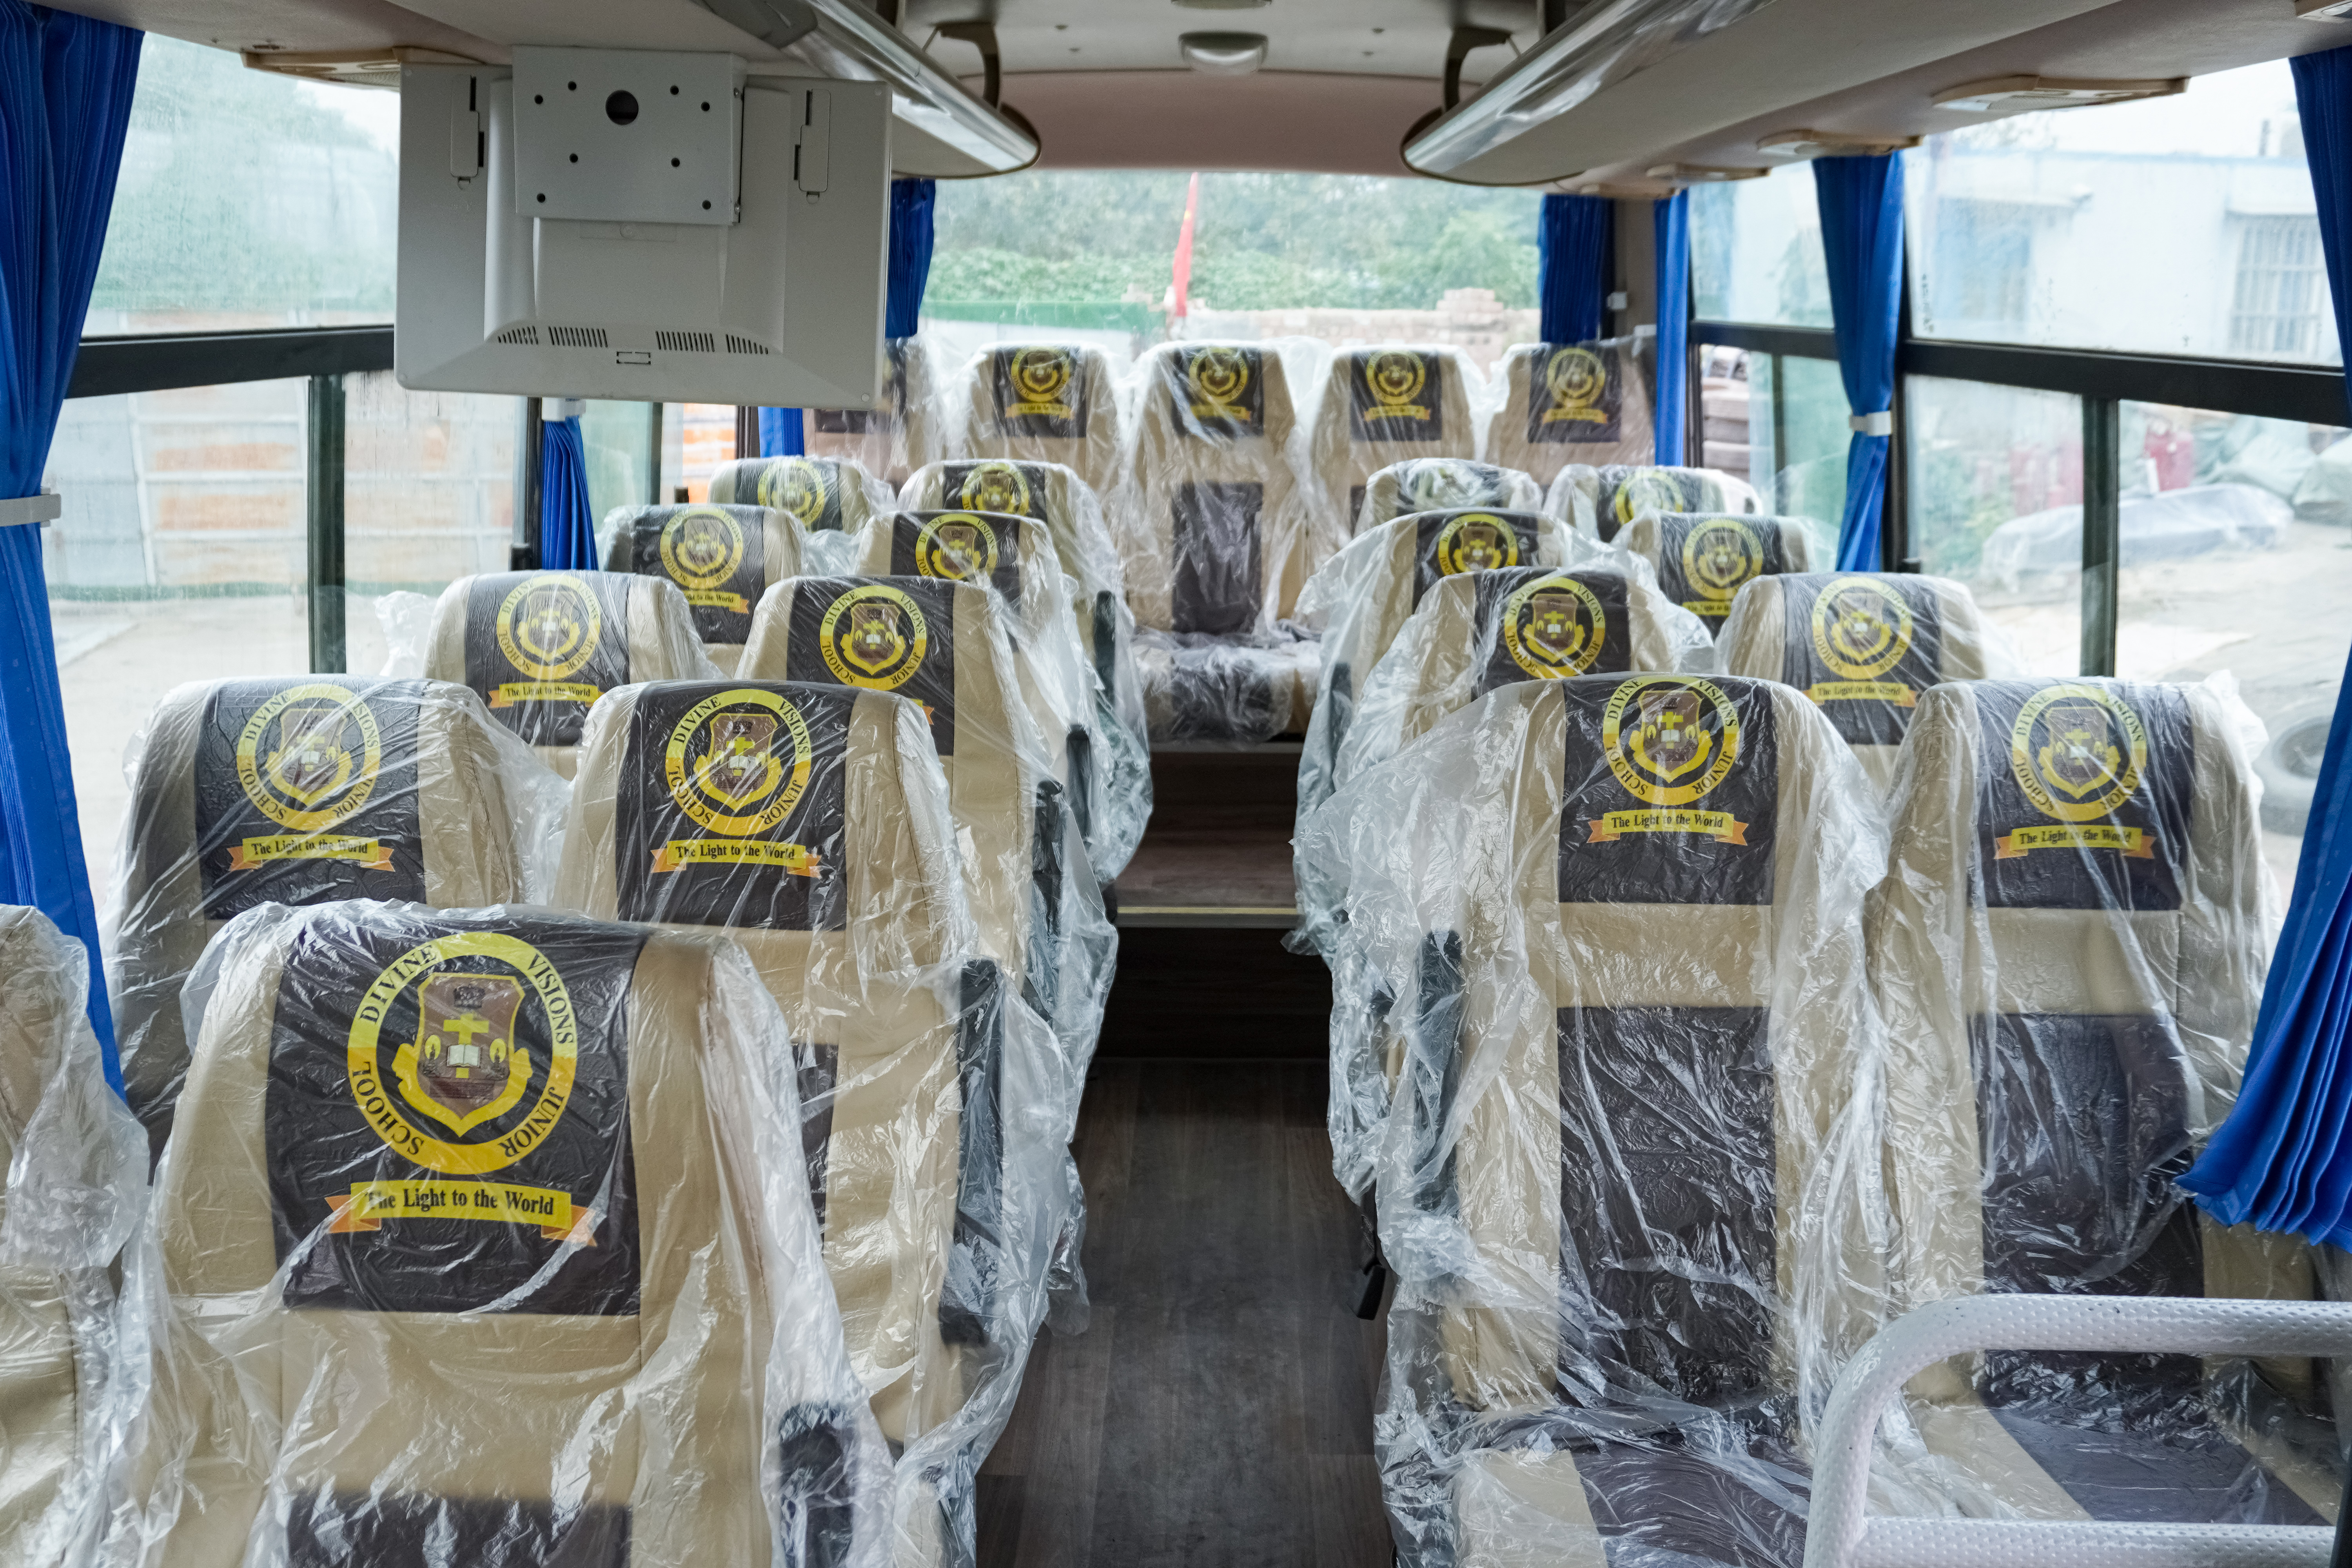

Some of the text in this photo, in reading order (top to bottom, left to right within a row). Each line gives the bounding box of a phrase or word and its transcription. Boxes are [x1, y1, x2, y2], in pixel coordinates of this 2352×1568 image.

[919, 517, 944, 544] DIINE
[717, 594, 733, 603] World
[1577, 585, 1603, 622] VISIONS
[822, 591, 925, 684] DIVINE VISIONS JUNIOR SCHOOL
[505, 688, 519, 697] The
[569, 686, 590, 697] World
[1608, 679, 1643, 720] DIVINE
[1697, 680, 1737, 727] VISIONS
[1818, 687, 1831, 695] The
[1835, 686, 1853, 696] Light
[246, 692, 291, 741] DIVINE
[352, 702, 379, 748] ISIONS
[668, 696, 809, 825] DIVINE VISIONS JUNIOR SCHOOL
[1691, 751, 1733, 795] JUNIOR
[240, 763, 287, 820] SCHOOL
[1612, 814, 1724, 828] The Light to the World
[2020, 832, 2038, 844] The
[2042, 831, 2067, 844] Light
[2084, 829, 2098, 840] the
[251, 843, 271, 855] The
[305, 840, 314, 850] to
[318, 839, 333, 850] the
[676, 844, 795, 860] The Light to the World
[352, 944, 574, 1158] DIVINE VISIONS JUNIOR SCHOOL
[403, 1188, 446, 1214] Light
[452, 1191, 467, 1207] to
[474, 1190, 498, 1209] the
[505, 1191, 554, 1215] World
